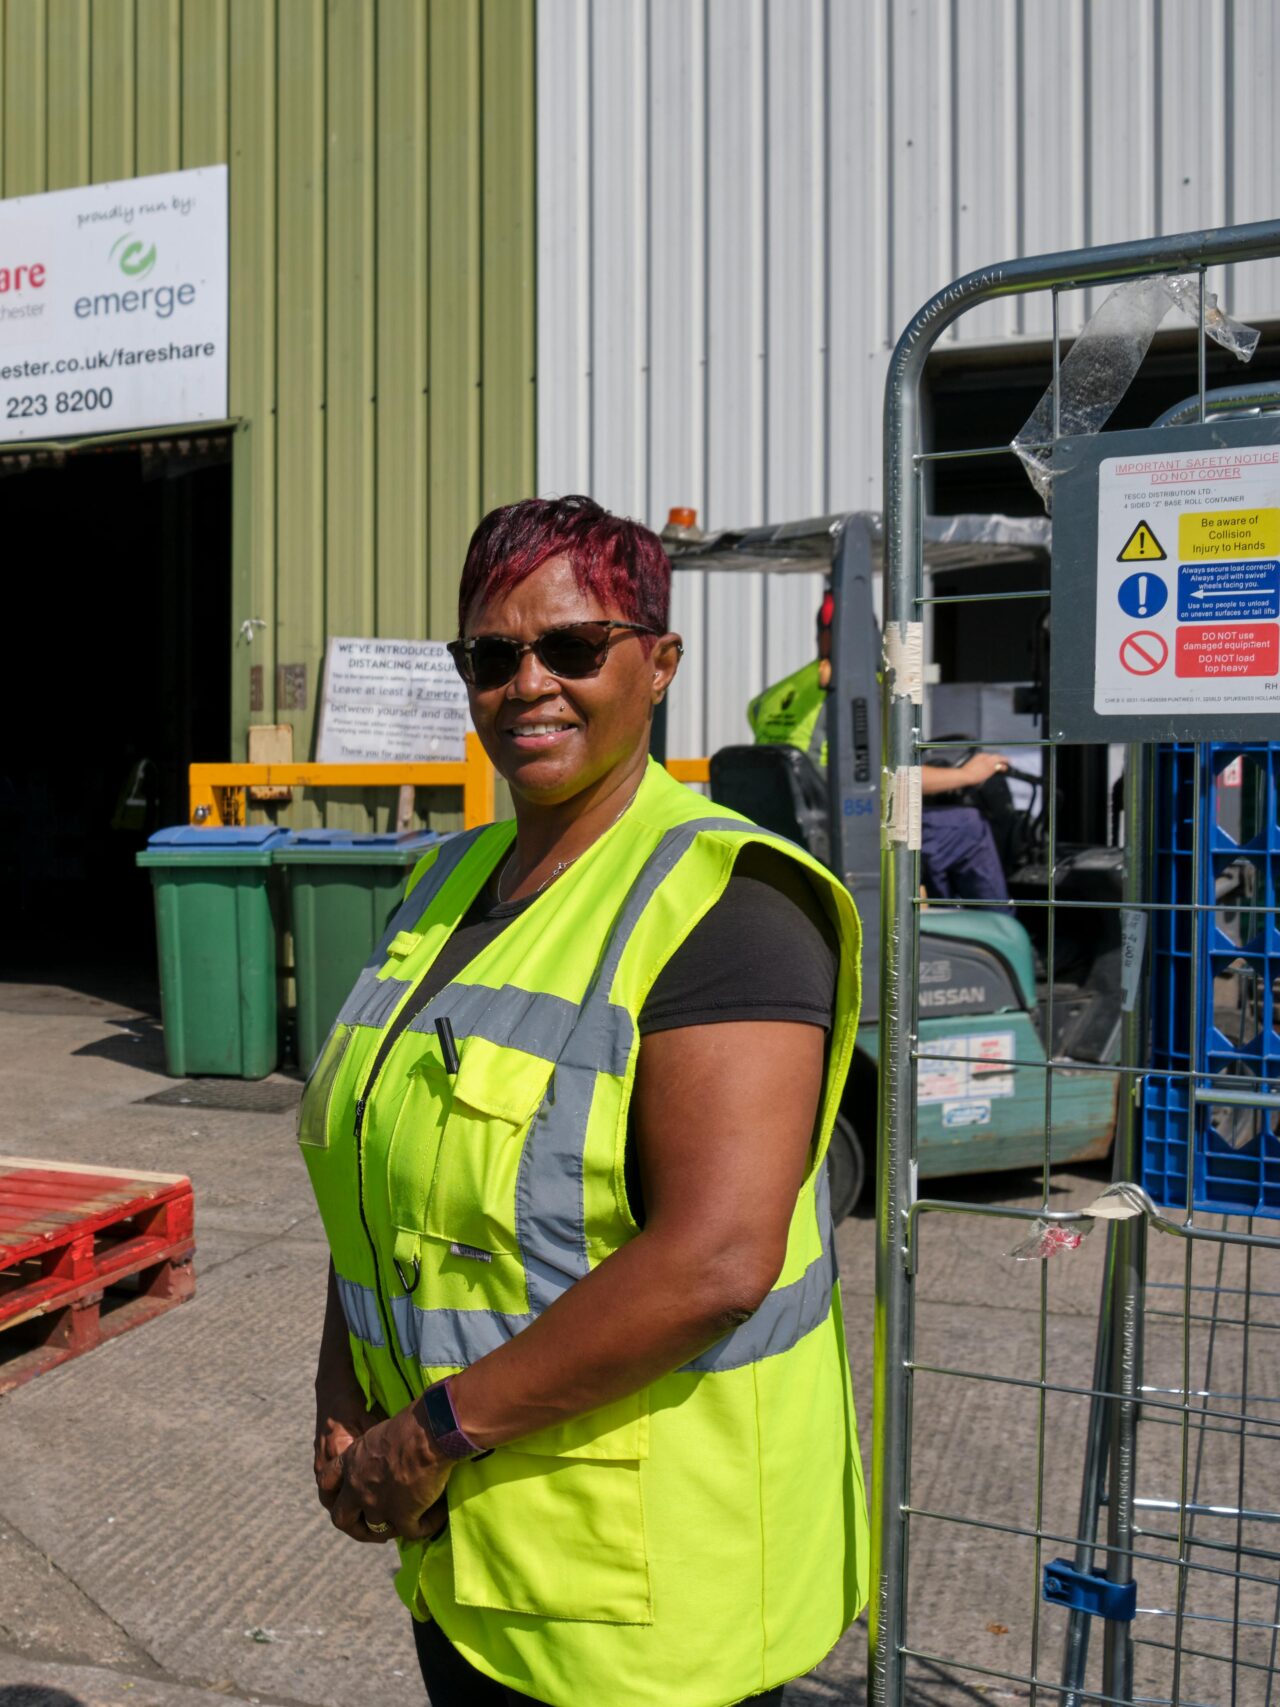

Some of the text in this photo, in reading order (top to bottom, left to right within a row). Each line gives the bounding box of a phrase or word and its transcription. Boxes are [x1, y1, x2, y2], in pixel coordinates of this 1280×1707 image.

[77, 205, 134, 229] proudly
[140, 202, 167, 215] run
[74, 283, 195, 318] emerge
[6, 394, 48, 420] 223
[56, 386, 113, 414] 8200
[1115, 452, 1280, 473] IMPORTANT SAFETY NOTICE
[1151, 468, 1241, 483] DO NOT COVER
[1148, 490, 1195, 498] DISTRIBUTION
[1205, 496, 1244, 504] CONTAINER
[1201, 515, 1259, 527] Be aware of
[1209, 530, 1251, 540] Collision
[1193, 541, 1265, 555] Injury to Hands
[1182, 567, 1205, 575] Always
[1246, 563, 1276, 572] correctly
[1223, 581, 1244, 589] facing
[1215, 601, 1237, 609] people
[1202, 631, 1254, 641] DO NOT use
[338, 644, 371, 653] WE'VE
[375, 644, 444, 657] INTRODUCED
[1183, 640, 1271, 651] damaged equipment
[1198, 653, 1255, 663] DO NOT load
[348, 658, 456, 672] DISTANCING MEASU
[1205, 664, 1248, 674] top heavy
[333, 684, 361, 695] Leave
[365, 685, 375, 695] at
[380, 685, 403, 696] least
[416, 687, 424, 699] 2
[426, 688, 460, 699] metre
[1264, 682, 1278, 690] RH
[330, 703, 374, 713] between
[378, 704, 418, 717] yourself
[421, 708, 440, 720] and
[919, 987, 985, 1007] NISSAN
